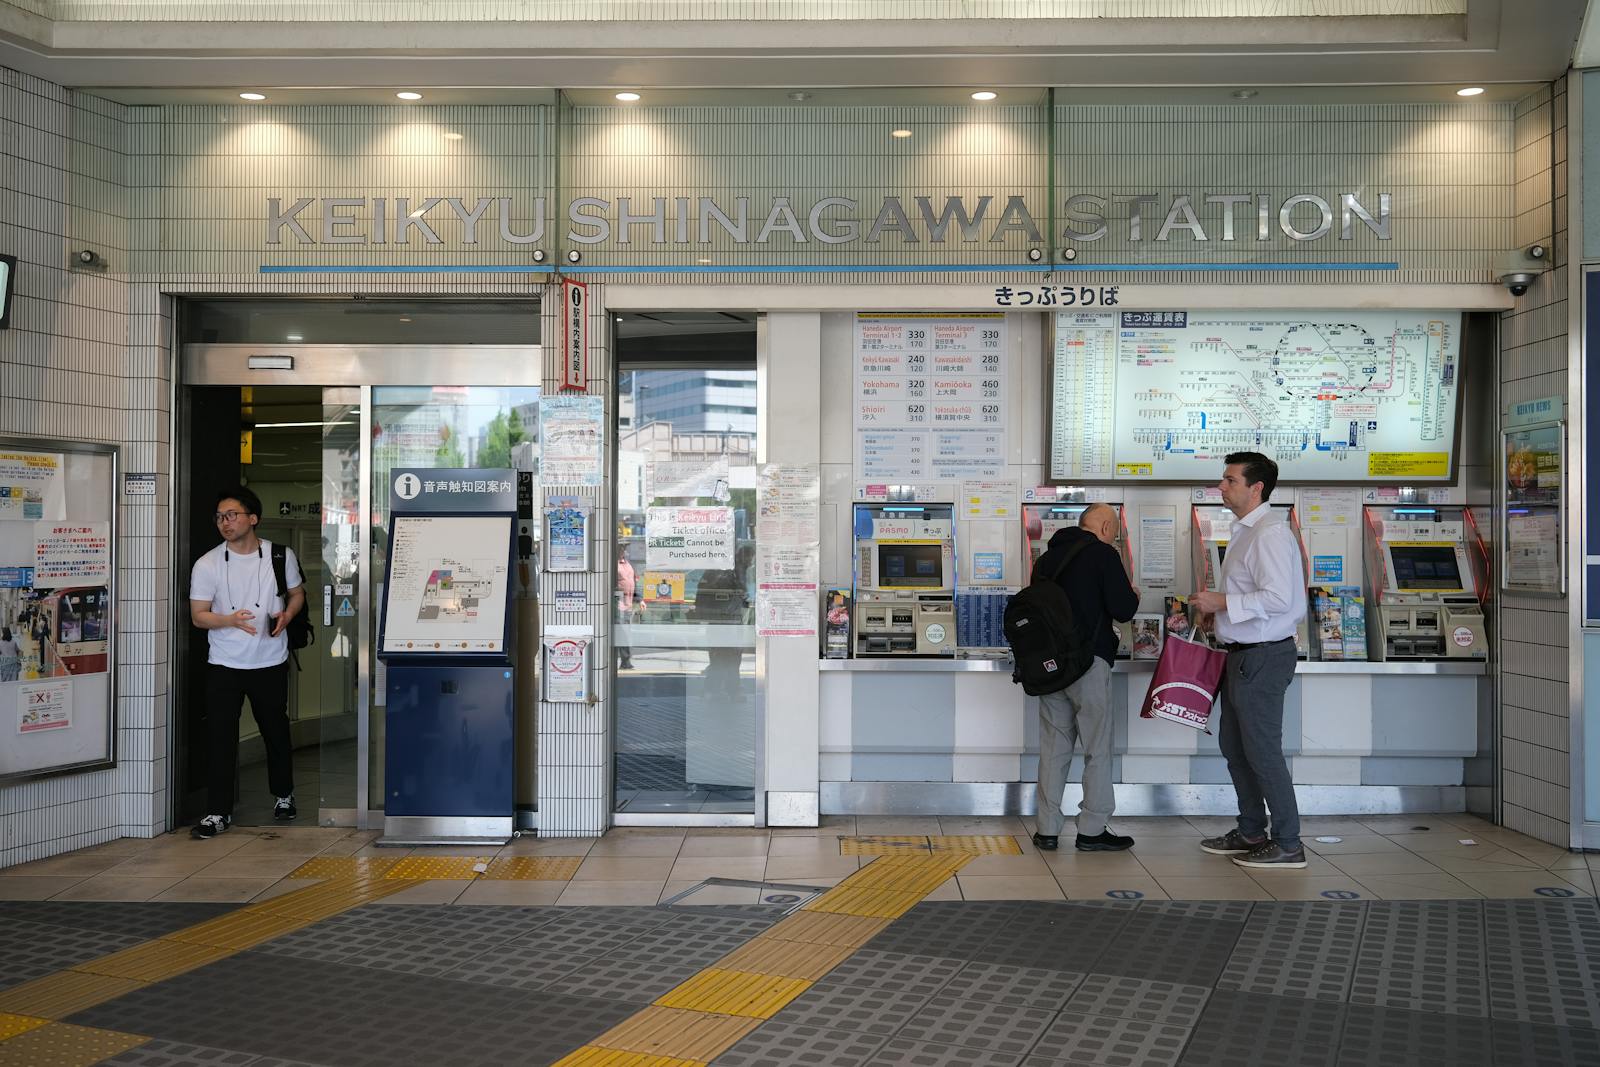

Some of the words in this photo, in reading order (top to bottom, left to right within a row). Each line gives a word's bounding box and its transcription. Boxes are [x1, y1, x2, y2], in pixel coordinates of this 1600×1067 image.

[266, 196, 547, 246] KEIKYU
[566, 195, 1045, 245] SHINAGAWA
[1063, 193, 1392, 243] STATION
[994, 286, 1120, 306] きっぷうりば
[1123, 312, 1185, 322] きっぷ運賃表
[956, 325, 975, 333] Airport
[908, 330, 925, 339] 330
[982, 330, 999, 339] 330
[910, 340, 923, 348] 170
[984, 340, 997, 348] 170
[908, 355, 925, 364] 240
[982, 355, 999, 364] 280
[910, 365, 923, 373] 120
[984, 365, 997, 373] 140
[863, 380, 900, 388] Yokohama
[908, 380, 925, 388] 320
[982, 380, 999, 388] 460
[908, 405, 925, 413] 620
[982, 405, 999, 413] 620
[1517, 403, 1535, 416] KEIKYU
[1536, 401, 1551, 412] NEWS
[909, 414, 923, 422] 310
[983, 414, 997, 422] 310
[423, 481, 512, 493] 音声触知図案内
[859, 489, 864, 498] 1
[1026, 490, 1034, 499] 2
[1195, 490, 1204, 499] 3
[1367, 491, 1376, 500] 4
[678, 513, 707, 523] Keikyu
[673, 526, 699, 535] Ticket
[660, 538, 684, 546] Tickets
[715, 538, 724, 546] be
[669, 551, 707, 559] Purchased
[27, 571, 34, 583] 3
